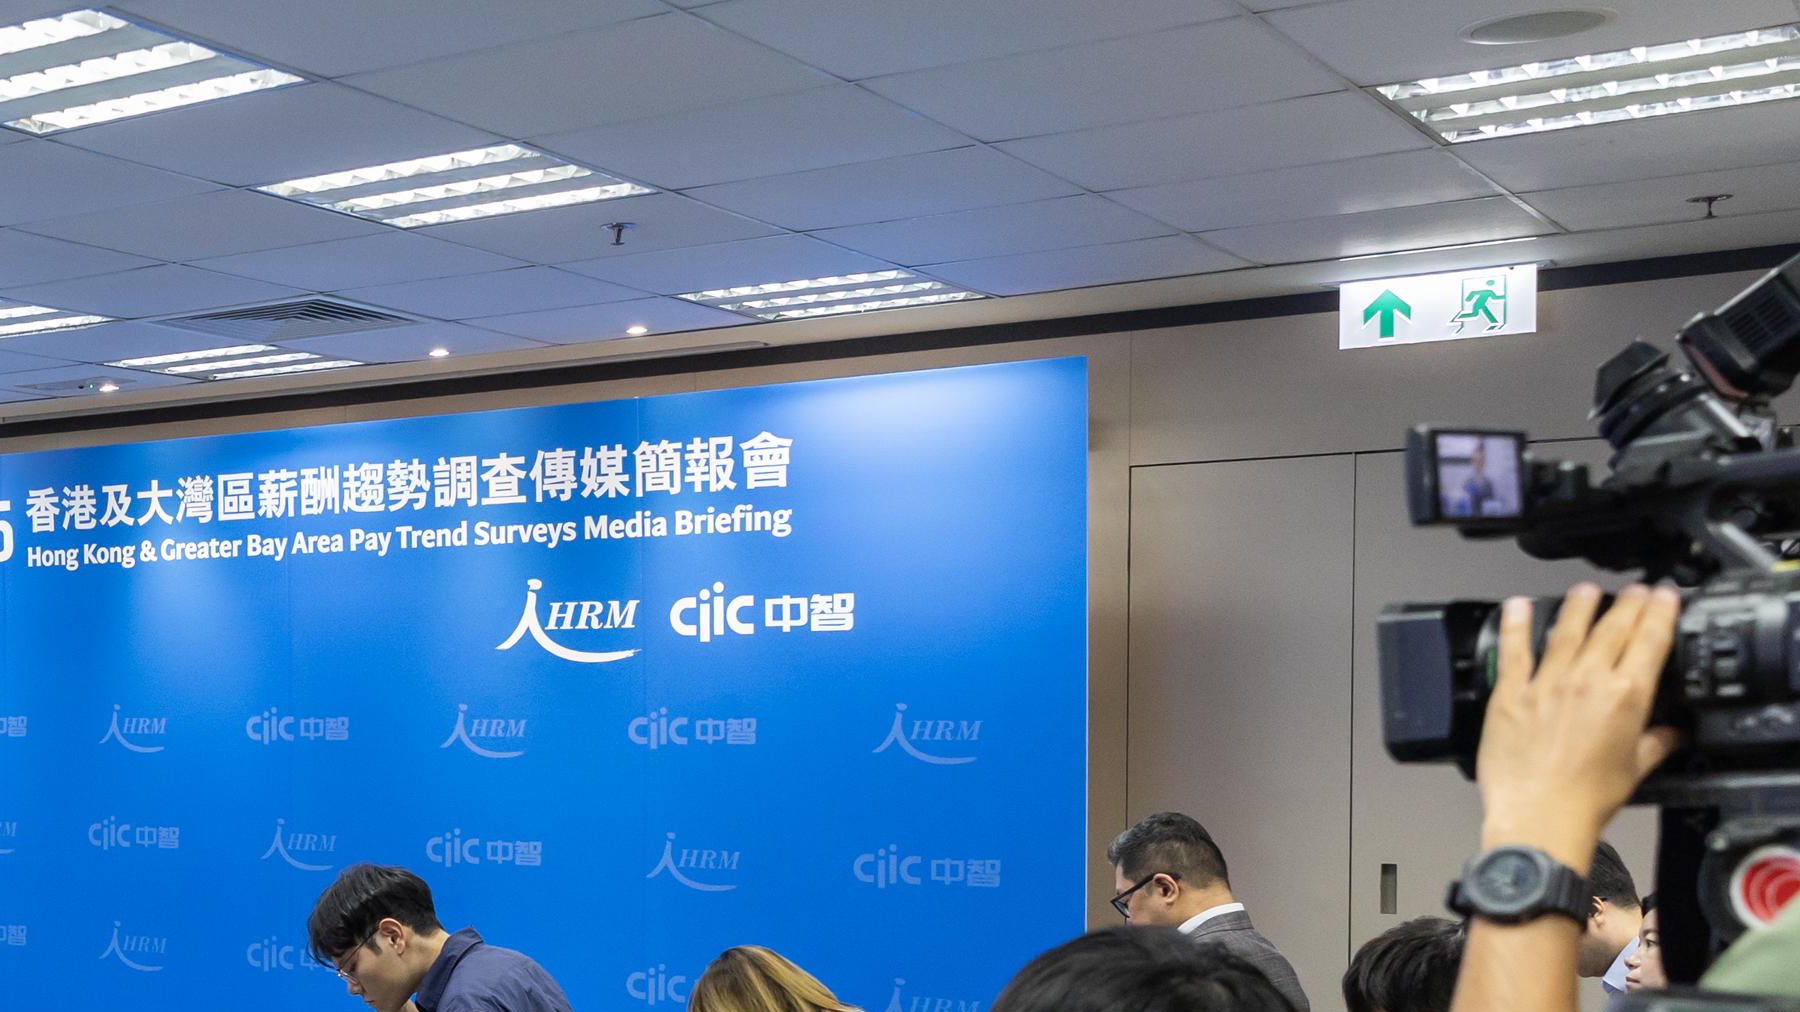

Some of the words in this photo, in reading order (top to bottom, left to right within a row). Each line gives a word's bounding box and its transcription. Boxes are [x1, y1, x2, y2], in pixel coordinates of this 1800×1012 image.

[26, 430, 794, 533] 香港及大灣區薪酬趨勢調查傳媒簡報會
[27, 546, 79, 571] Hong
[83, 542, 136, 568] Kong
[139, 542, 158, 561] &
[161, 537, 241, 560] Greater
[246, 533, 289, 562] Bay
[292, 531, 344, 555] Area
[349, 527, 392, 557] Pay
[397, 519, 468, 549] Trend
[474, 518, 577, 549] Surveys
[585, 510, 668, 540] Media
[675, 504, 793, 538] Briefing
[764, 591, 856, 633] 中智
[300, 715, 350, 743] 中智
[695, 717, 758, 747] 中智
[134, 824, 180, 850] 中智
[485, 839, 543, 868] 中智
[929, 857, 1002, 888] 中智
